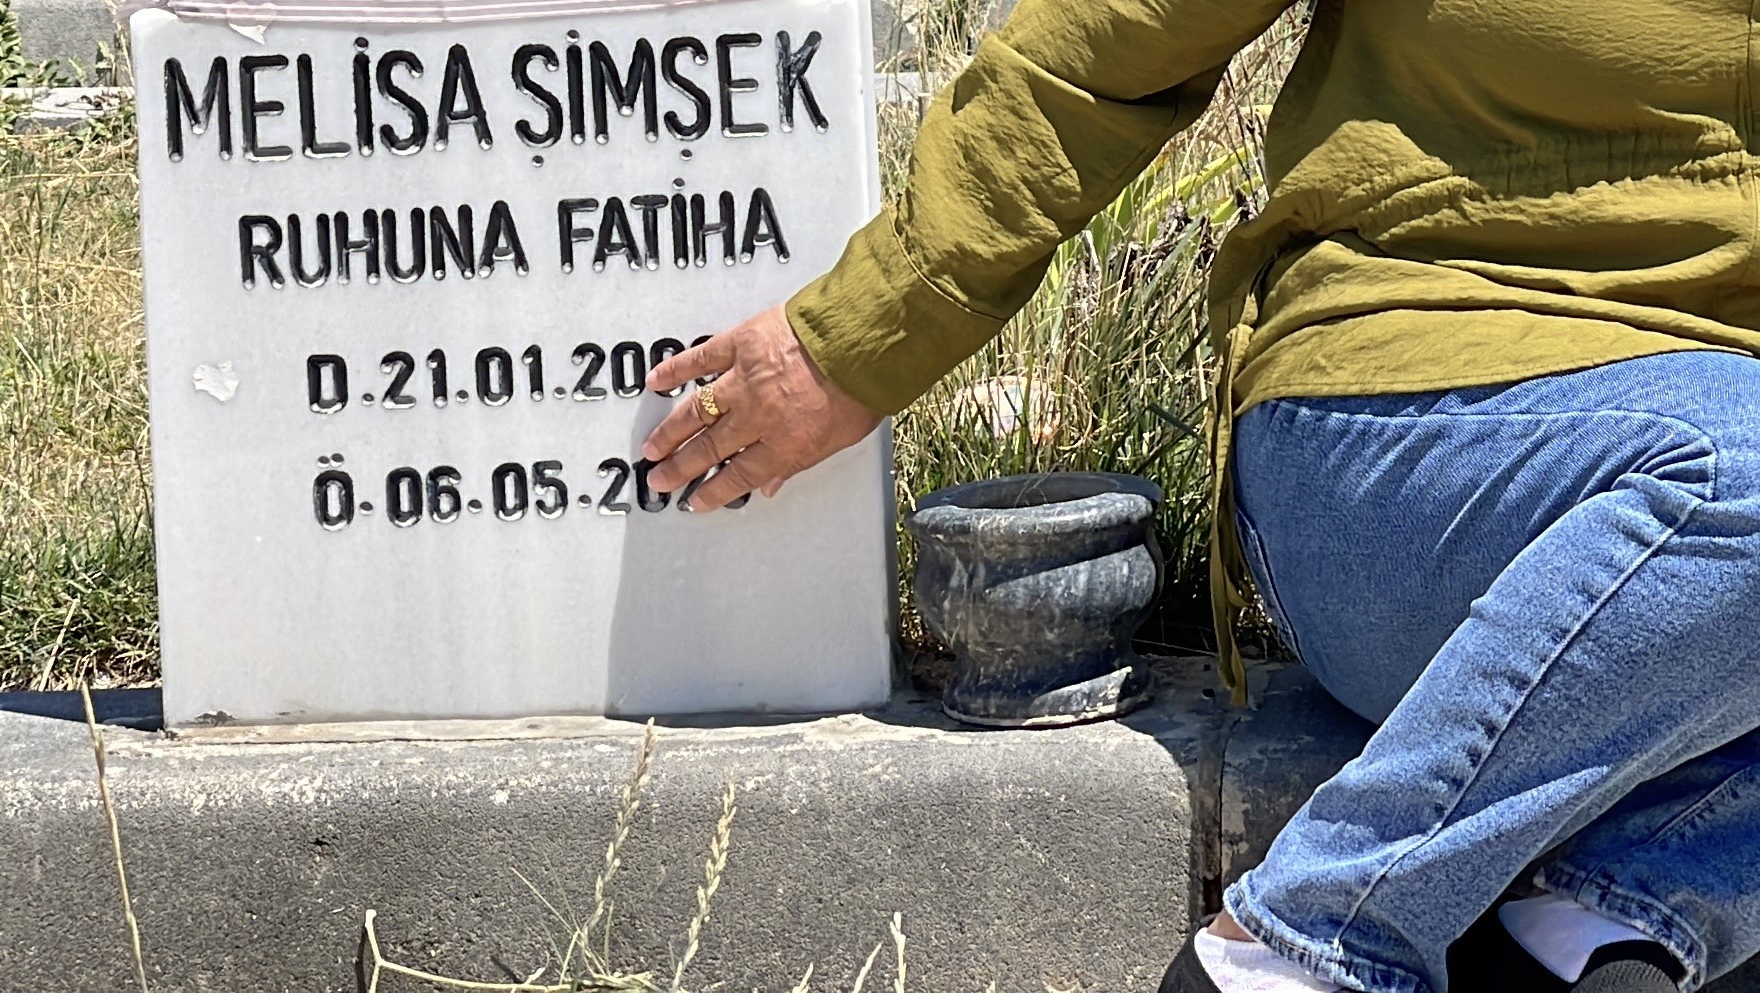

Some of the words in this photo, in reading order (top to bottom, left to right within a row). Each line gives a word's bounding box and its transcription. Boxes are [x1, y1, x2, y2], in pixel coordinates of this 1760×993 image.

[162, 35, 494, 163] MELİSA
[511, 27, 830, 170] ŞİMŞEK
[238, 199, 530, 291] RUHUNA
[557, 175, 792, 275] FATİHA
[312, 452, 753, 533] Ö.06.05.20
